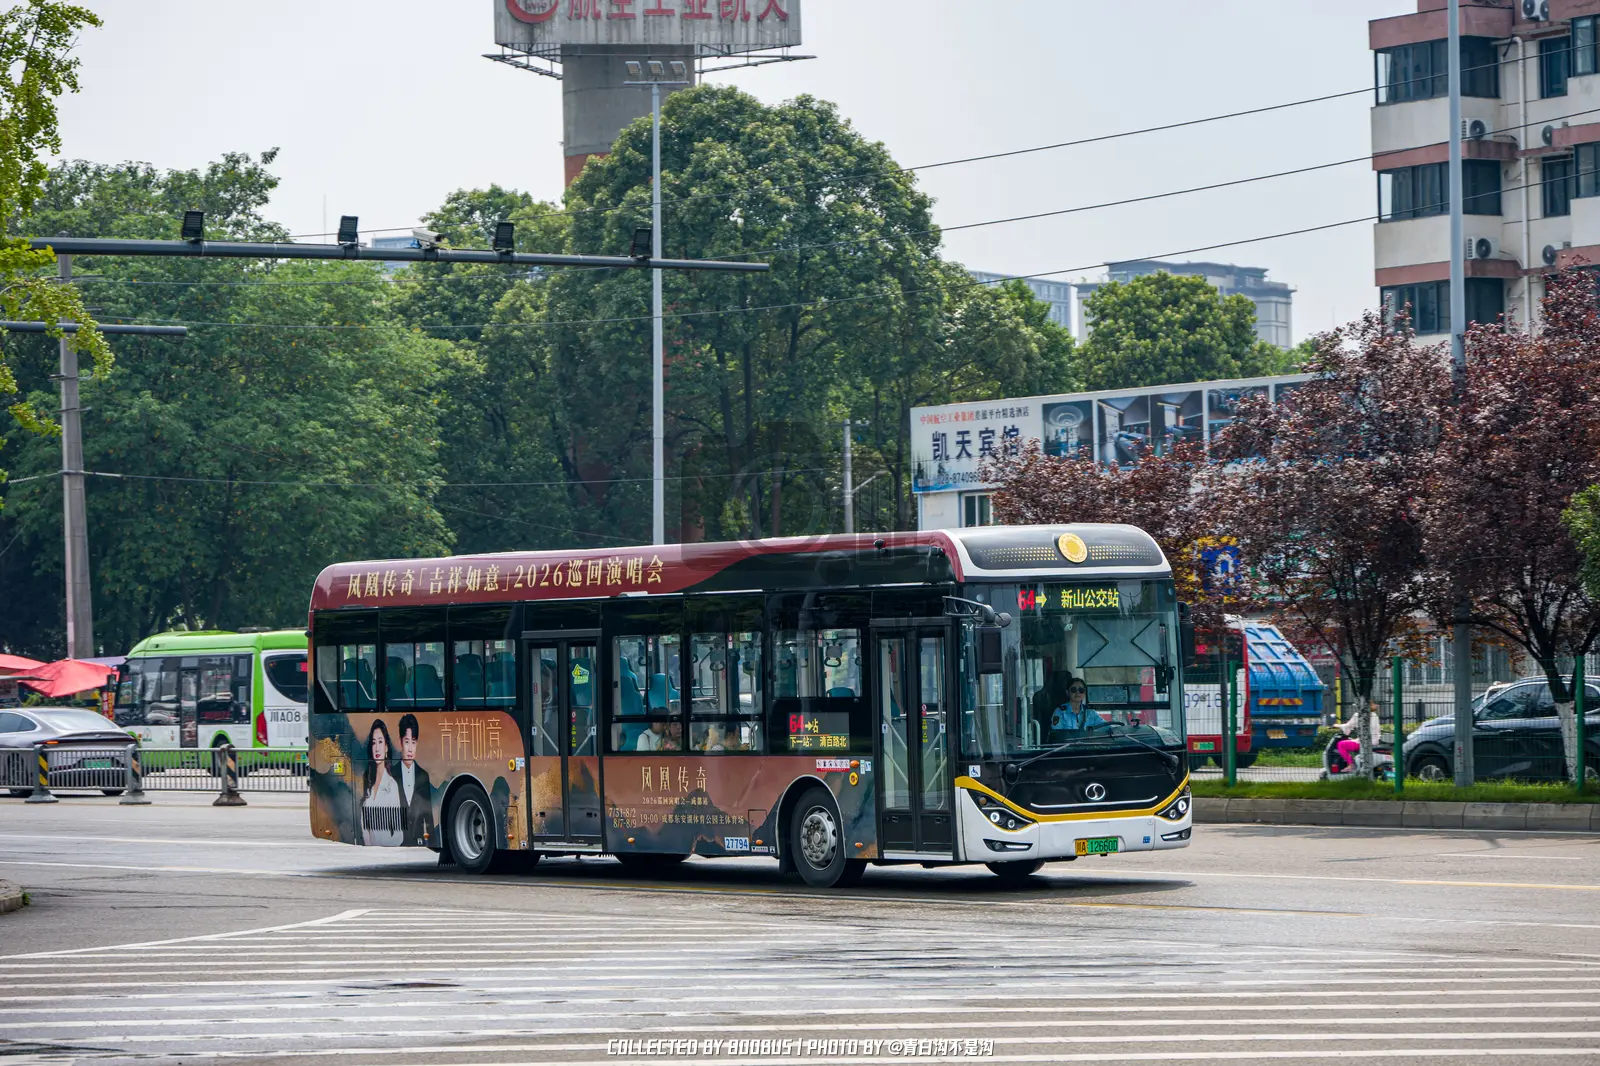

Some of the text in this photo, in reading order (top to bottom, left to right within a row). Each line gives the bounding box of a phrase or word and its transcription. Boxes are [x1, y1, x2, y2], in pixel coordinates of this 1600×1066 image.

[1017, 588, 1119, 611] 64 新山公交站
[789, 713, 804, 733] 64
[438, 717, 503, 761] 吉祥如意
[641, 766, 708, 793] 凤凰传奇
[726, 838, 748, 849] 27794
